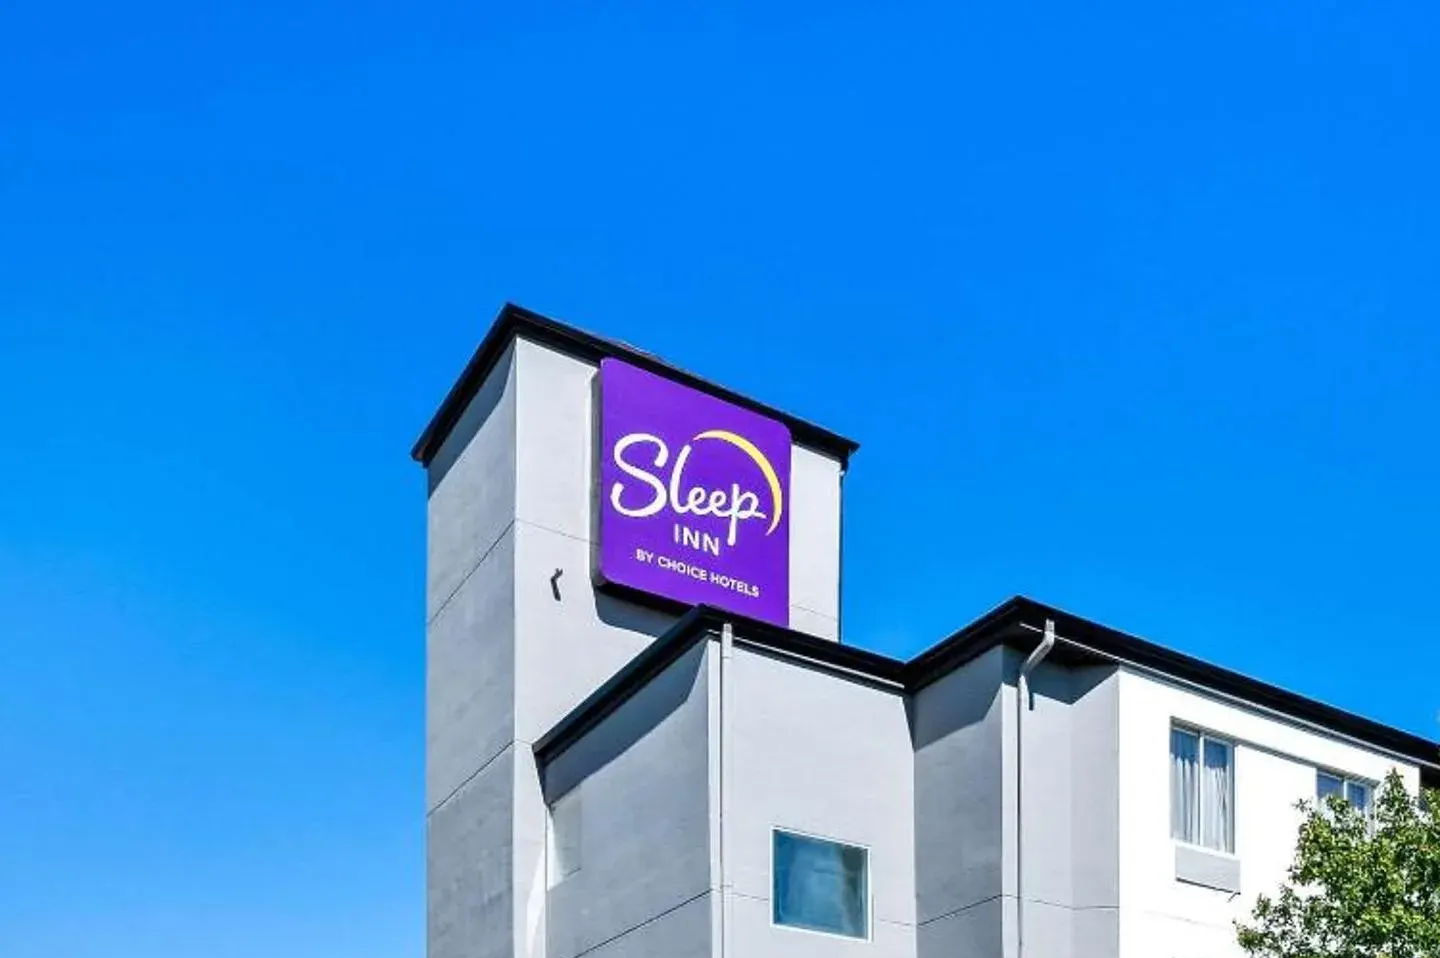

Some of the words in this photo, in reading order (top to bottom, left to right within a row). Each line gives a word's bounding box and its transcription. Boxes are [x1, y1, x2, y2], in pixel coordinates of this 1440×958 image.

[610, 433, 767, 546] Sleep
[673, 523, 720, 556] INN
[635, 548, 655, 564] BY
[657, 555, 708, 581] CHOICE
[710, 573, 760, 598] HOTELS
